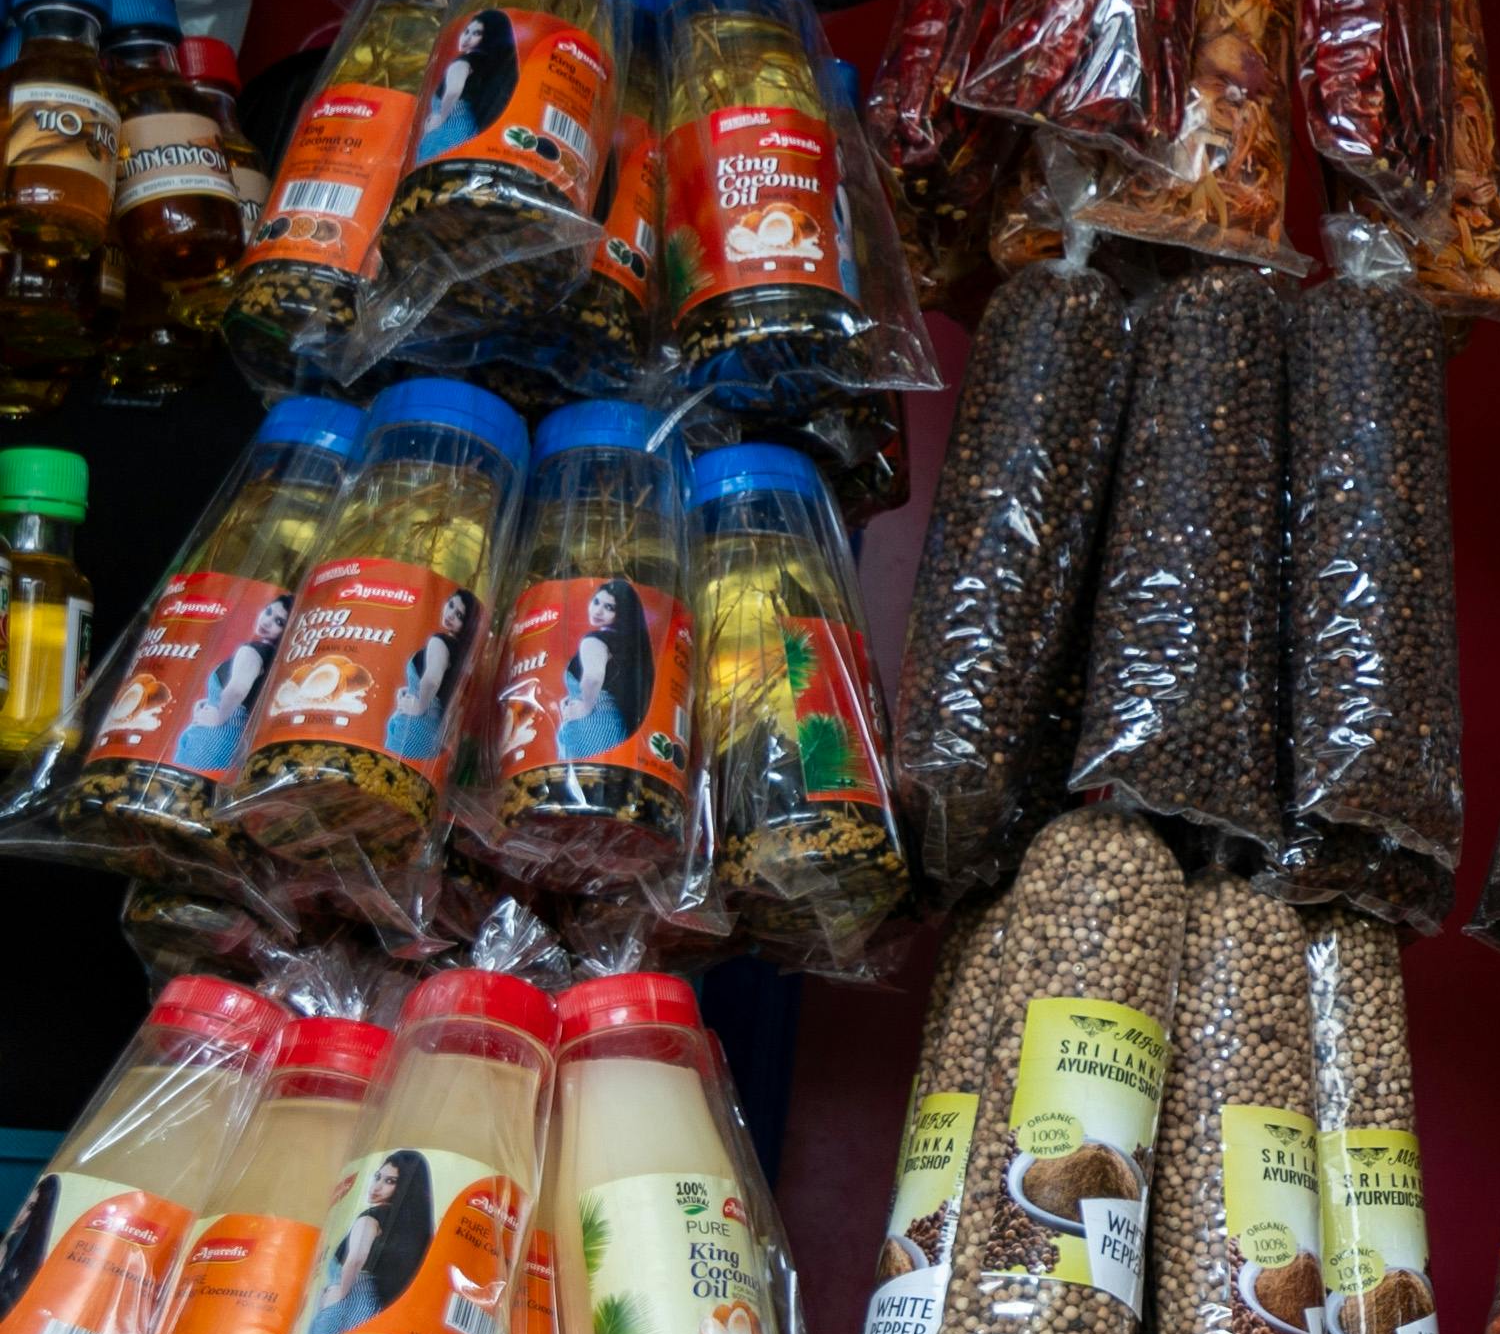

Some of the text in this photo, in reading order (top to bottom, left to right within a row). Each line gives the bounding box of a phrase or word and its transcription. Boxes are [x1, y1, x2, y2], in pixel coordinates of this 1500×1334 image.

[717, 155, 779, 175] King
[717, 173, 821, 195] Coconut
[720, 187, 759, 209] Oil
[292, 624, 396, 646] Coconut
[1060, 1039, 1101, 1059] SRI
[1056, 1056, 1138, 1090] AYURVEDIC
[1026, 1113, 1077, 1130] ORGANIC
[1031, 1127, 1070, 1142] 100%
[1029, 1140, 1073, 1156] NATURAL
[1262, 1148, 1296, 1164] SRI
[920, 1155, 951, 1172] SHOP
[1343, 1173, 1381, 1188] SRI
[676, 1182, 708, 1198] 100%
[1345, 1190, 1416, 1207] AYURVEDIC
[676, 1196, 710, 1209] NATURAL
[461, 1216, 491, 1236] PURE
[686, 1220, 731, 1237] PURE
[1246, 1222, 1288, 1235] ORGANIC
[1253, 1238, 1287, 1251] 100%
[688, 1242, 740, 1267] King
[1255, 1251, 1291, 1265] NATURAL
[693, 1280, 728, 1300] Oil
[875, 1296, 936, 1319] WHITE
